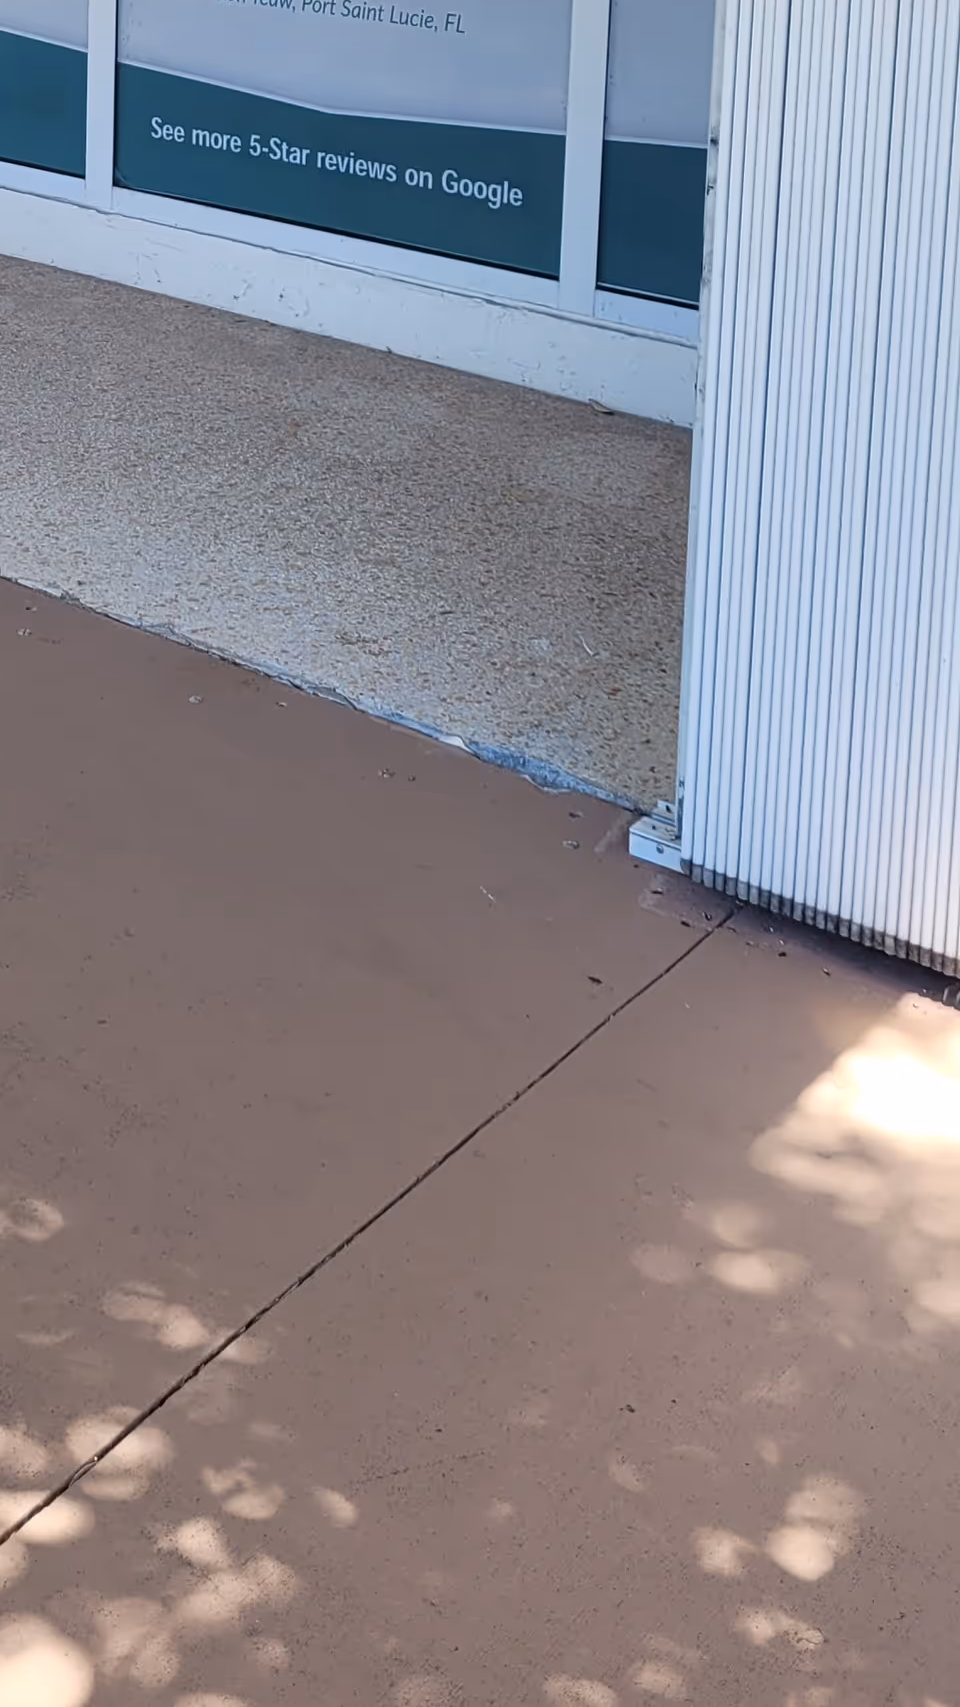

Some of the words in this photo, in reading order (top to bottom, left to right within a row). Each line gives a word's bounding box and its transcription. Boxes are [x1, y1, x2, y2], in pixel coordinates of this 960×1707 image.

[389, 5, 439, 32] Lucie,
[444, 13, 466, 34] FL
[151, 116, 186, 143] See
[191, 128, 242, 153] more
[249, 134, 311, 166] 5-Star
[317, 151, 397, 183] reviews
[405, 166, 433, 190] on
[442, 169, 524, 209] Google
